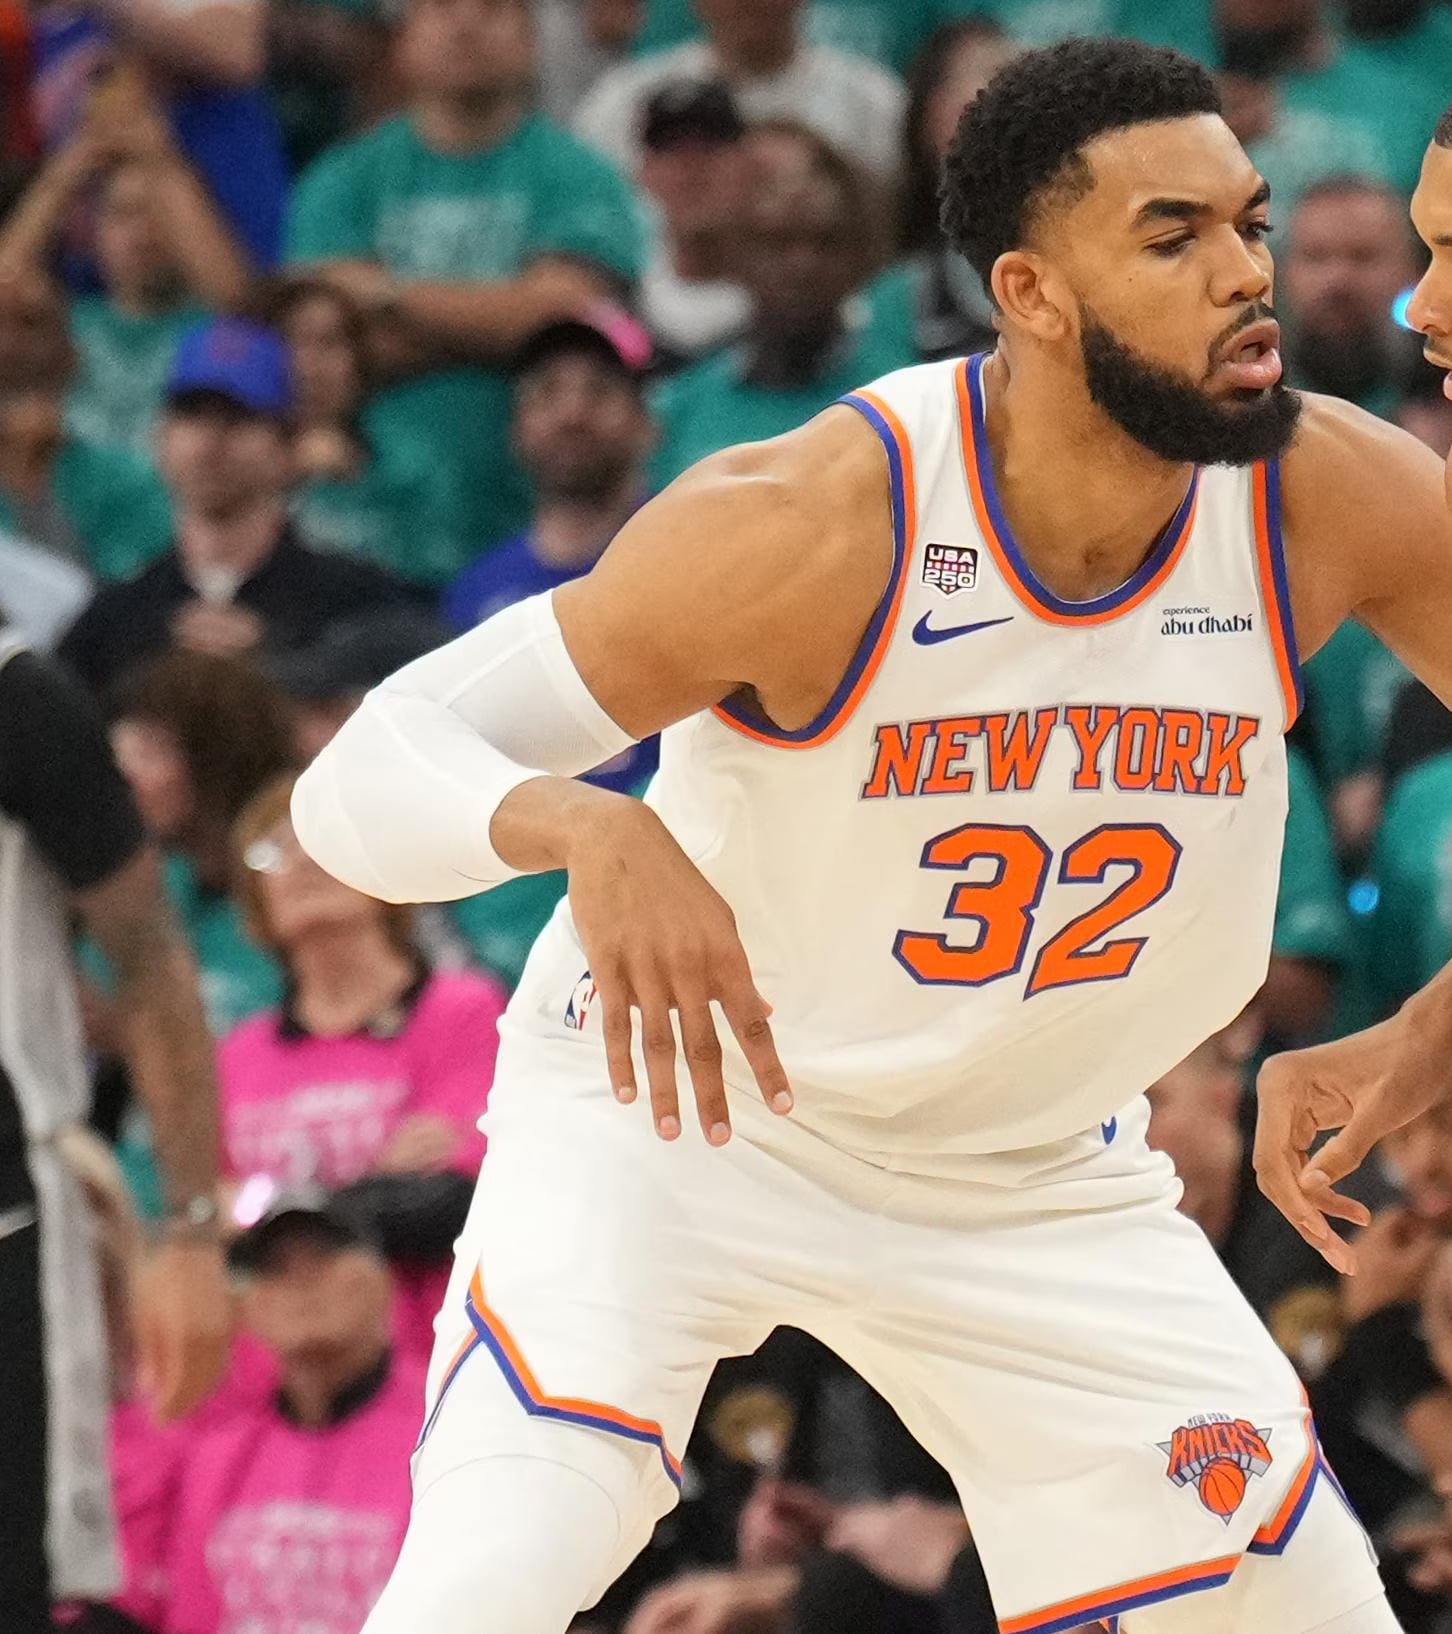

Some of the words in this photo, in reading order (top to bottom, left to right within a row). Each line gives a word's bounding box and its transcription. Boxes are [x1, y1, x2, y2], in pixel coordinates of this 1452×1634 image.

[928, 547, 975, 564] USA
[924, 568, 975, 587] 250
[1161, 617, 1194, 635] abu
[1198, 613, 1253, 634] dhabi
[861, 705, 1059, 800] NEW
[1063, 703, 1261, 799] YORK
[892, 823, 1183, 1001] 32
[1167, 1418, 1273, 1482] KNICKS
